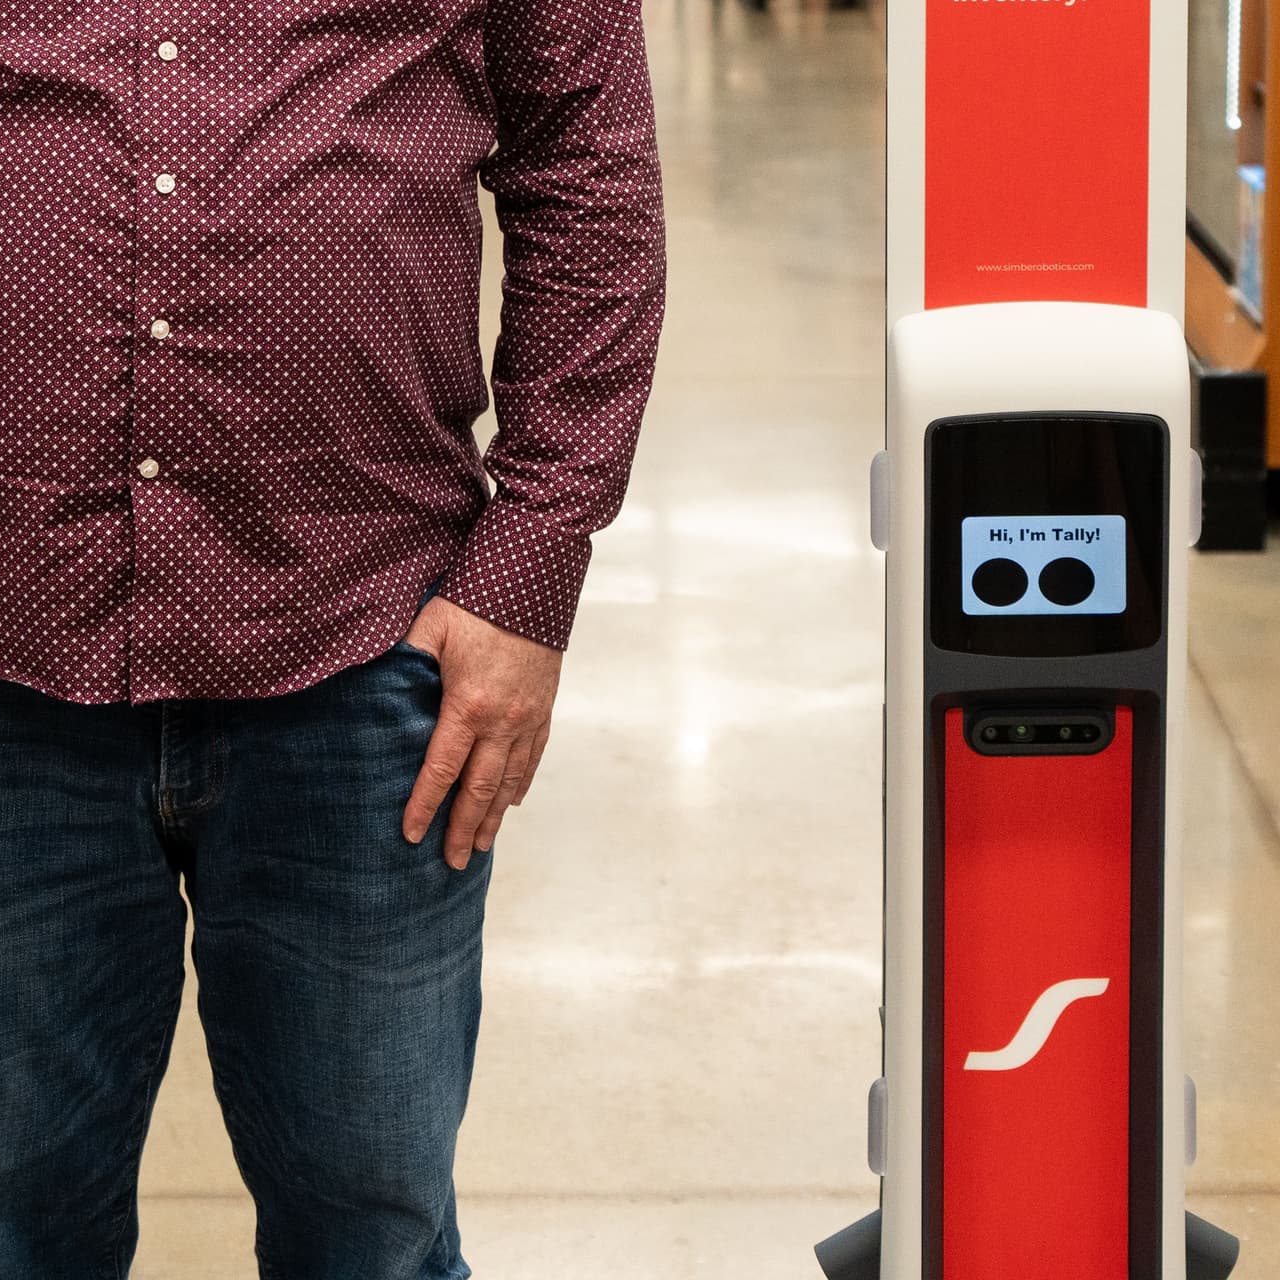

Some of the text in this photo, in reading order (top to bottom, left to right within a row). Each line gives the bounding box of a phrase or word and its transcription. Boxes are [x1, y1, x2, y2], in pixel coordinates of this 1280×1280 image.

[976, 262, 1095, 273] www.simberobotics.com
[989, 528, 1101, 544] Hi, I'm Tally!
